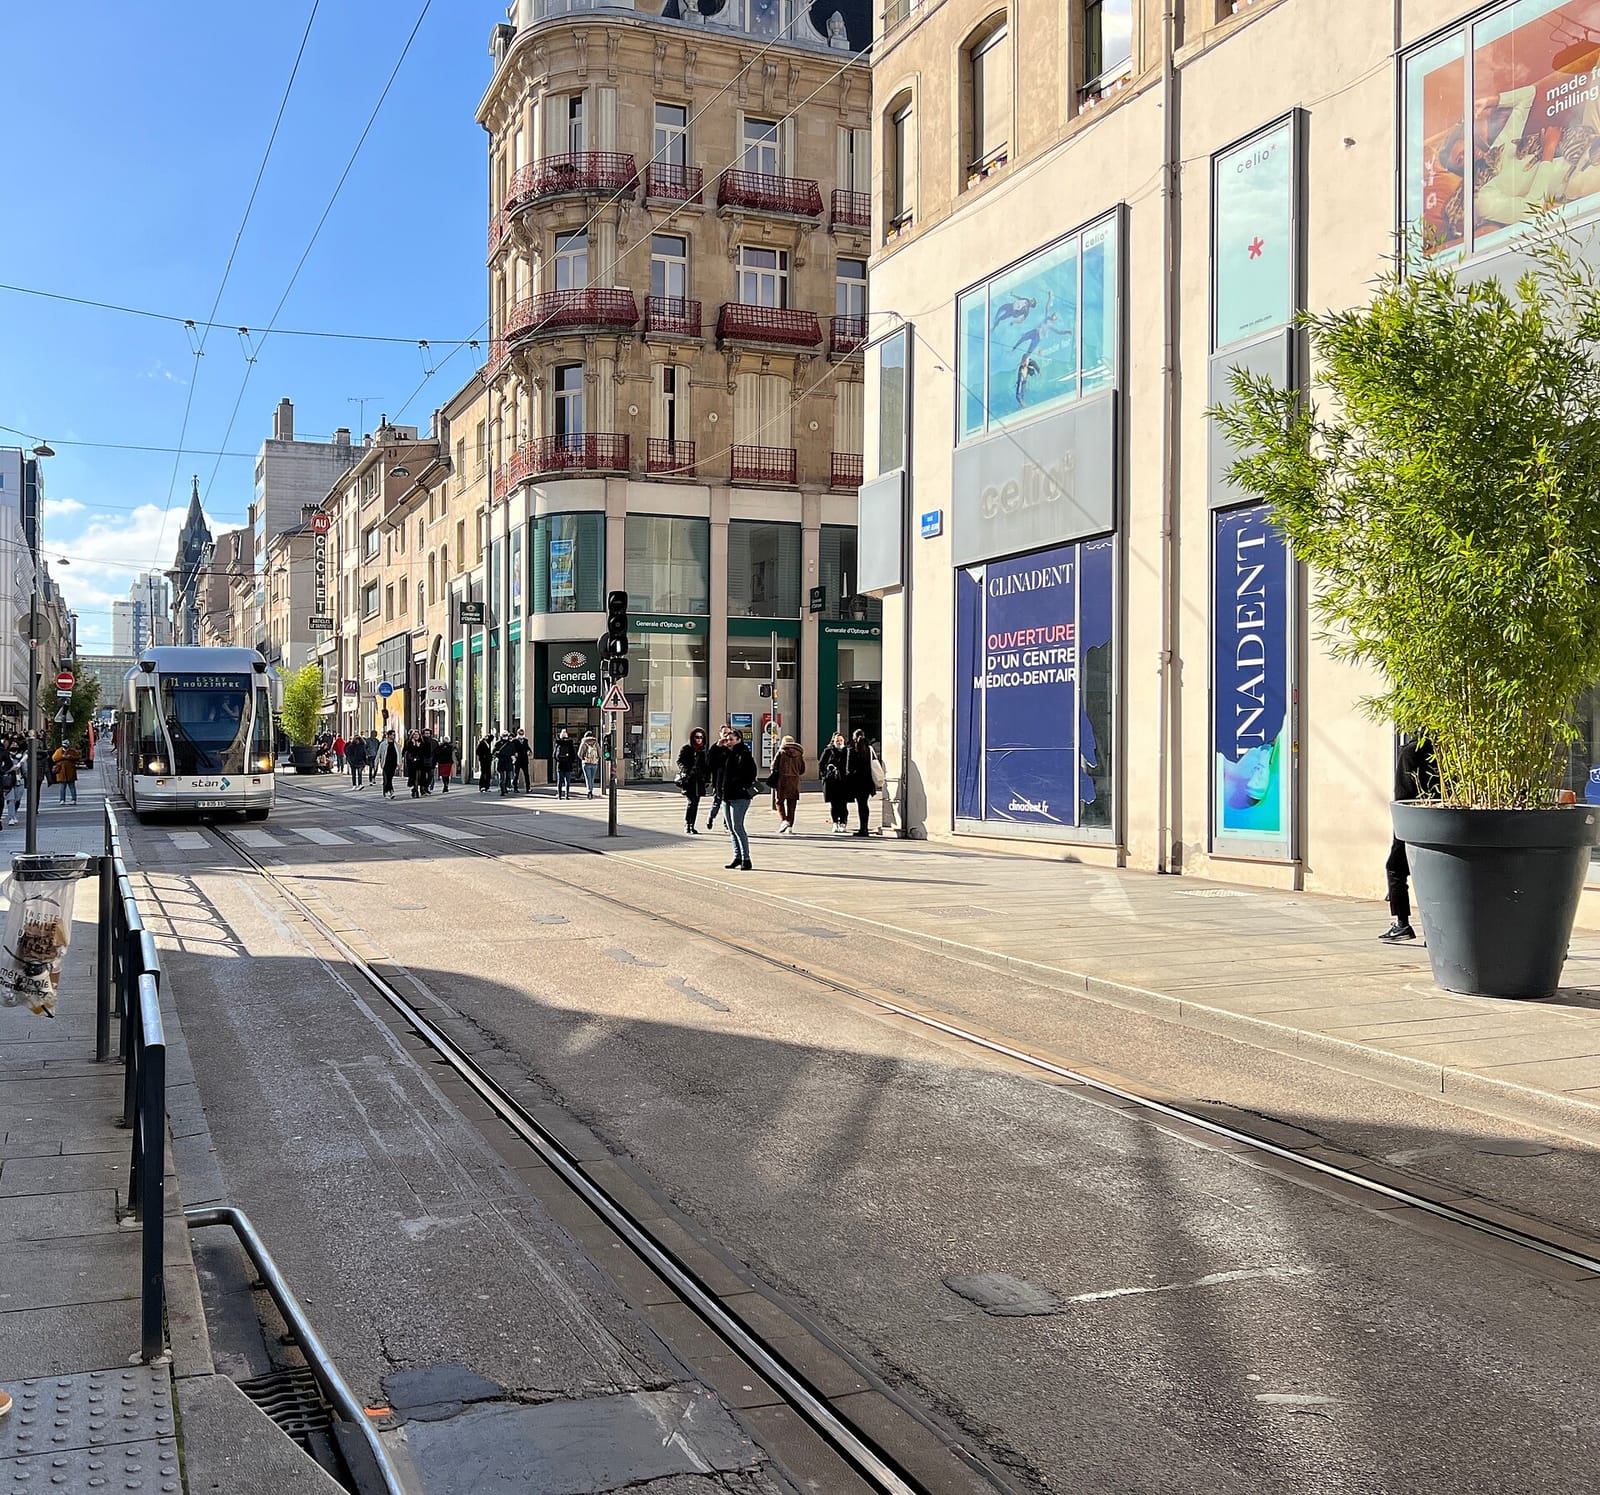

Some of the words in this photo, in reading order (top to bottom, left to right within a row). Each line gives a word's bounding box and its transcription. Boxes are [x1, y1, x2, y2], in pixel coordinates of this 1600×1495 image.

[1546, 74, 1588, 102] made
[1546, 85, 1599, 117] chilling
[315, 520, 327, 528] AU
[989, 563, 1074, 598] CLINADENT
[635, 620, 659, 628] Generale
[987, 623, 1075, 650] OUVERTURE
[987, 653, 1020, 671] D'UN
[1022, 647, 1075, 667] CENTRE
[552, 670, 597, 682] Generale
[551, 683, 598, 696] d'Optique
[191, 779, 219, 788] stan
